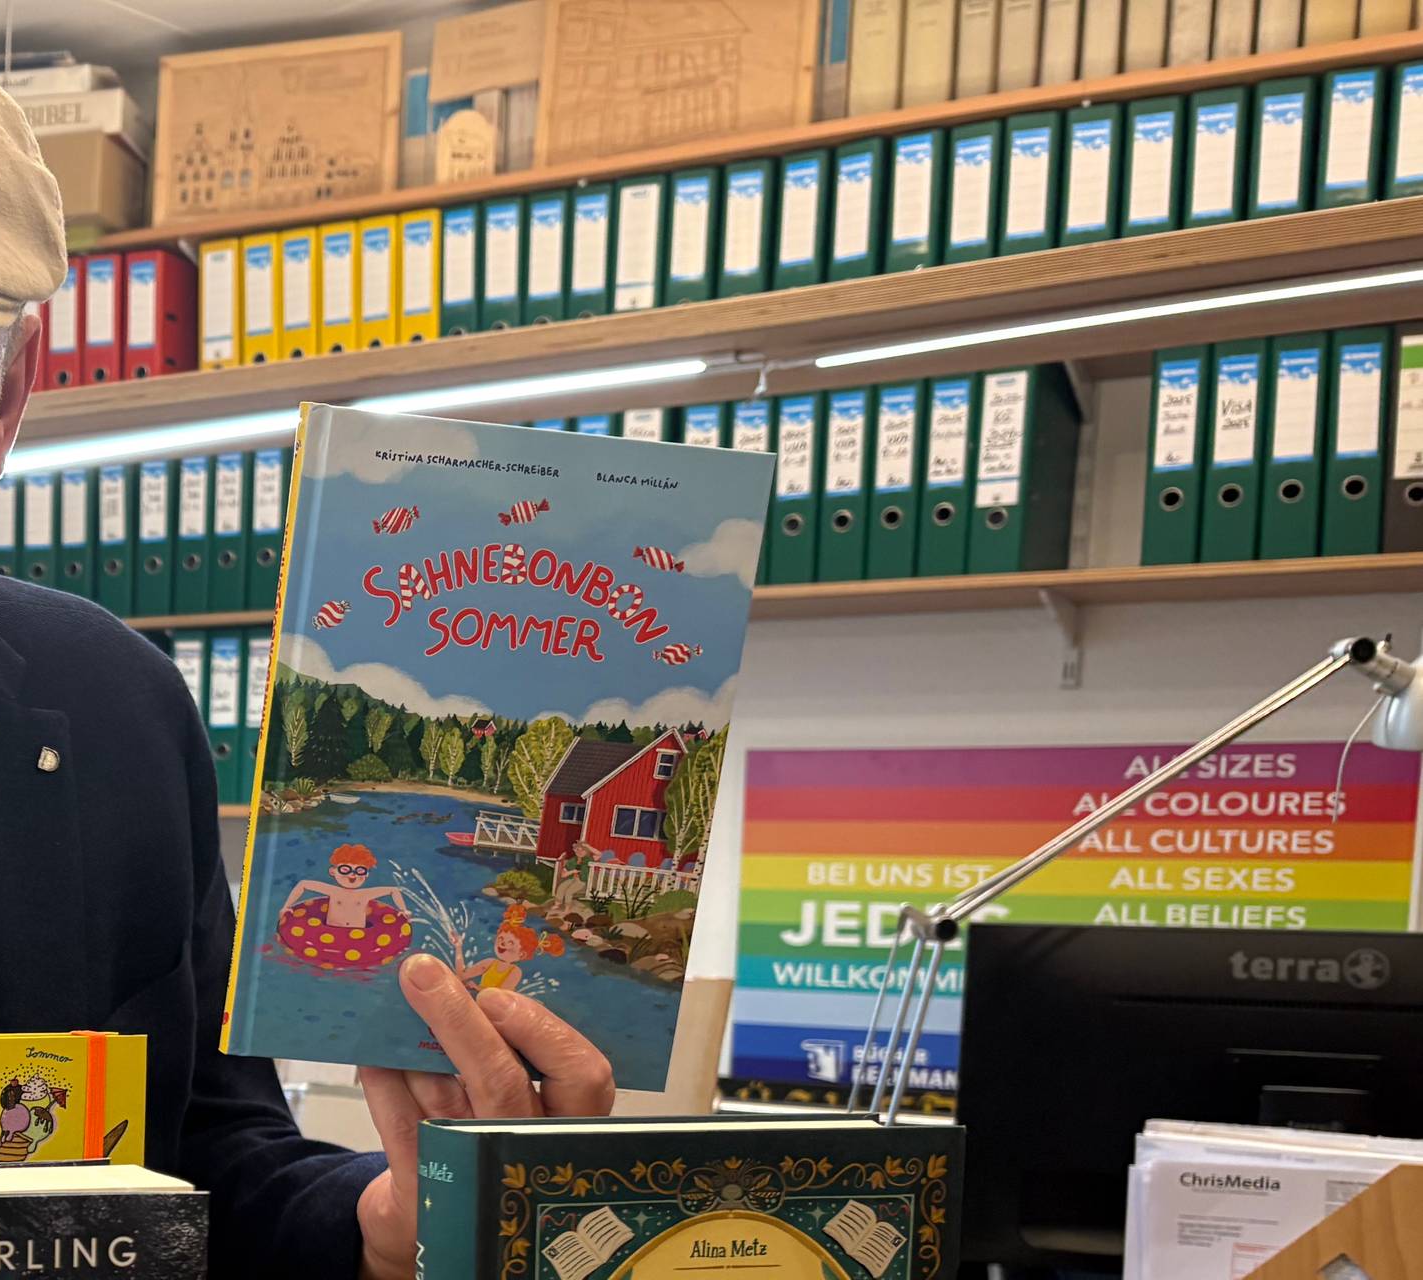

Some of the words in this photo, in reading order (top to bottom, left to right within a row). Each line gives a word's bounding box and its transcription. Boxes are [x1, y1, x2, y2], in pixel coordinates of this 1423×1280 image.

[596, 472, 638, 486] BLANCA
[362, 543, 669, 645] SAHNEBONBON
[425, 607, 606, 664] SOMMER
[1196, 753, 1297, 779] SIZES
[1144, 791, 1346, 817] COLOURES
[1078, 828, 1143, 853] ALL
[1149, 828, 1335, 854] CULTURES
[807, 861, 856, 885] BEI
[865, 863, 935, 887] UNS
[943, 863, 993, 888] IST
[1109, 866, 1173, 891] ALL
[1181, 866, 1296, 893] SEXES
[1094, 902, 1157, 927] ALL
[1165, 903, 1307, 929] BELIEFS
[1229, 950, 1340, 983] terra
[1179, 1172, 1281, 1191] ChrisMedia
[689, 1239, 727, 1258] Alina
[730, 1238, 768, 1258] Metz
